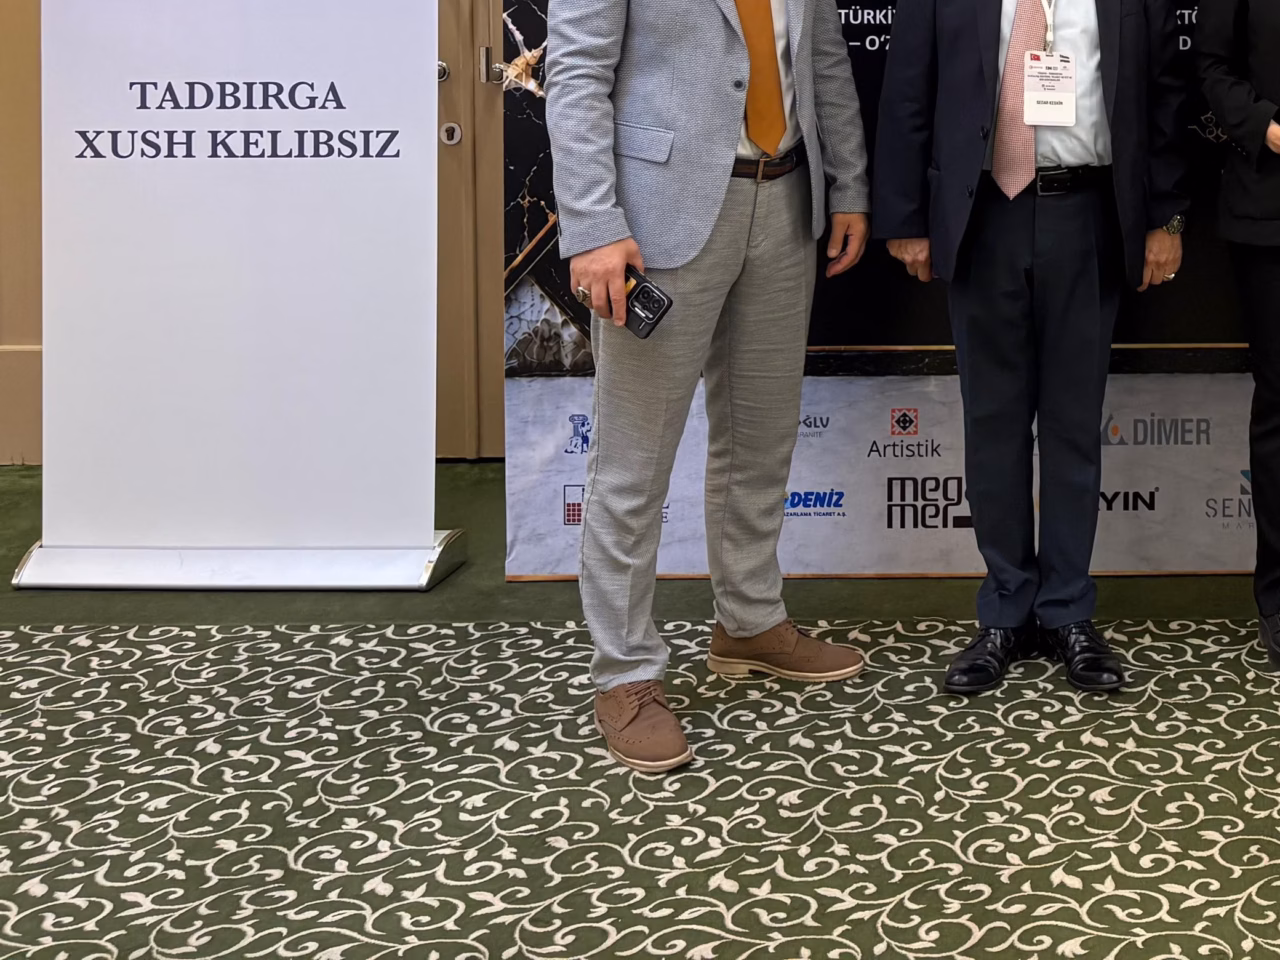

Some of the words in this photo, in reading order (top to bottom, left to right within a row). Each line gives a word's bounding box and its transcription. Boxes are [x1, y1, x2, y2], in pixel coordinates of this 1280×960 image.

[837, 6, 896, 24] TÜRKİ
[130, 82, 346, 109] TADBIRGA
[75, 130, 196, 158] XUSH
[208, 130, 400, 158] KELIBSIZ
[1133, 412, 1211, 445] DİMER
[868, 439, 941, 457] Artistik
